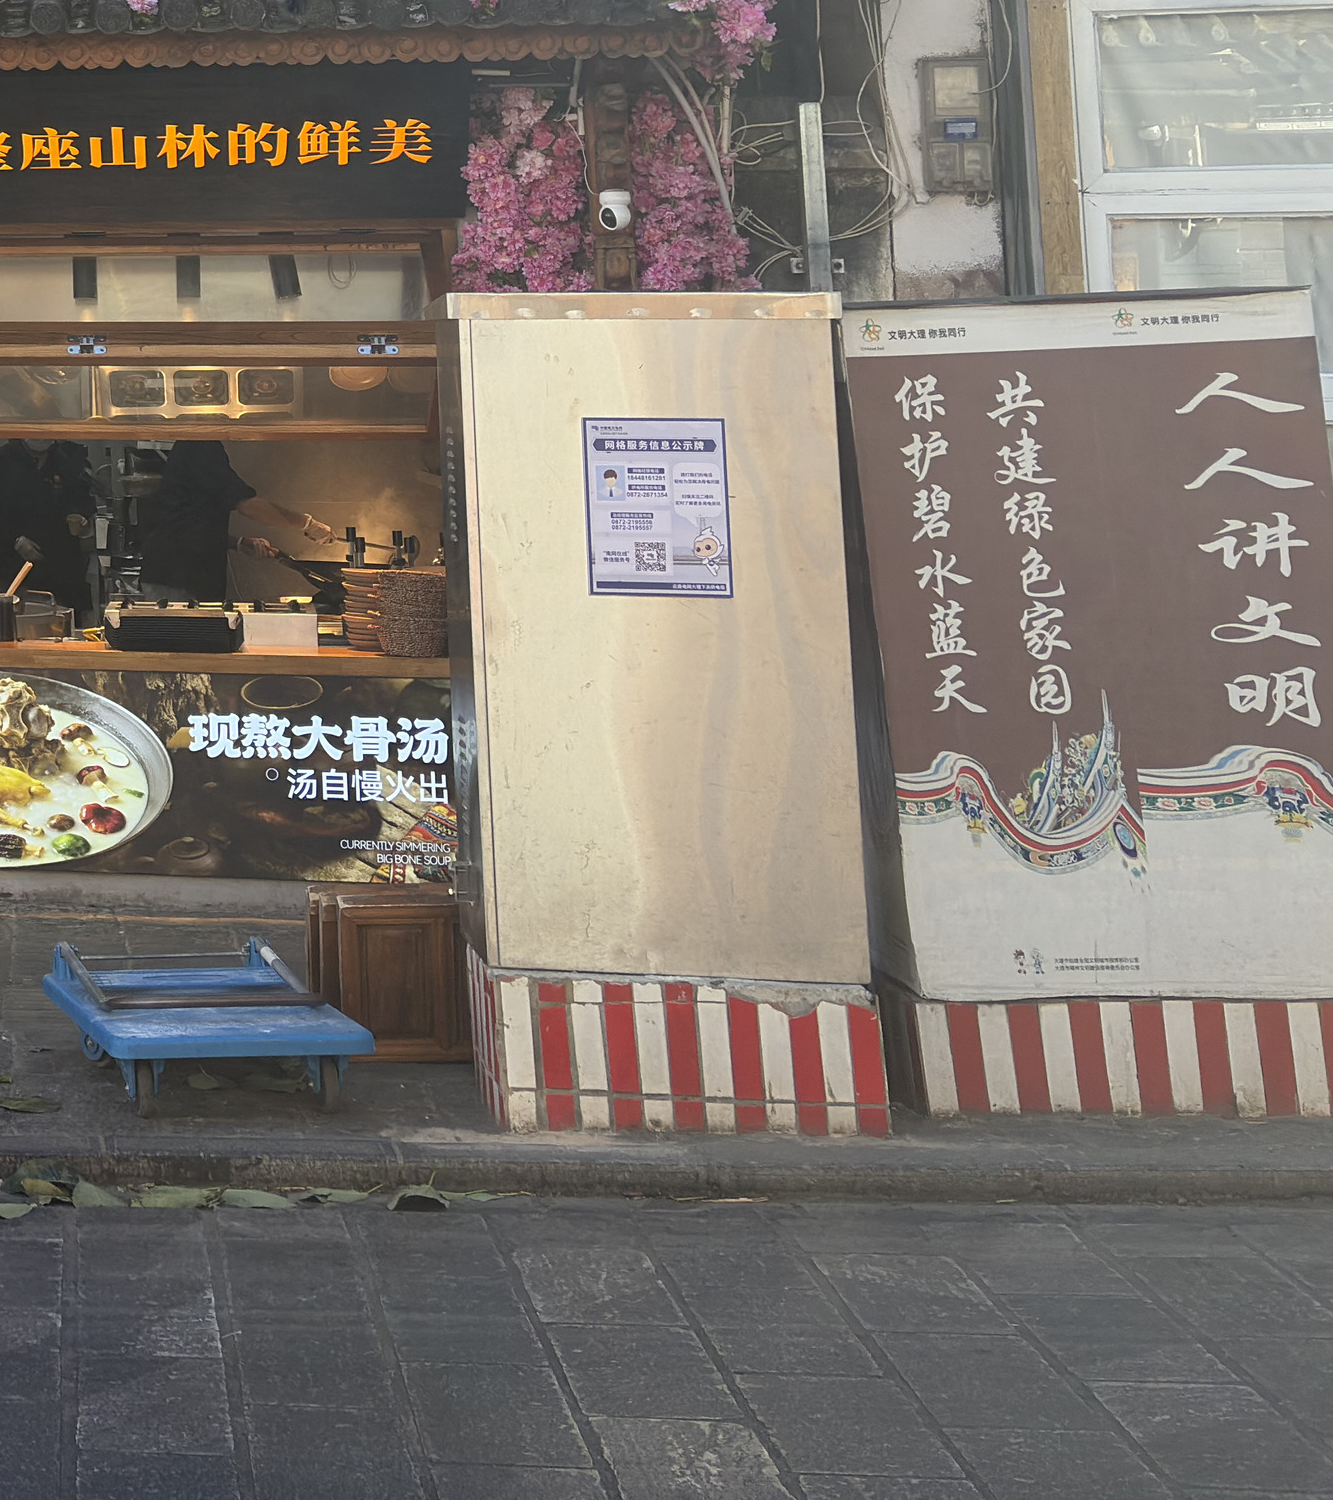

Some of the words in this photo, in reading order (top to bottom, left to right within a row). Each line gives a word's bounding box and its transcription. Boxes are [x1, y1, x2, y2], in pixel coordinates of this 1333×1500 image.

[1141, 316, 1179, 326] 文明大理
[1181, 314, 1219, 324] 你我同行
[888, 329, 926, 340] 文明大理
[928, 327, 966, 339] 你我同行
[605, 440, 704, 450] 网格服务信息公示牌
[895, 374, 987, 714] 保护碧水蓝天
[986, 371, 1072, 715] 共建绿色家园
[1175, 372, 1321, 728] 人人讲文明
[187, 712, 449, 764] 现熬大骨汤
[287, 767, 449, 804] 汤自慢火出
[340, 839, 394, 851] CURRENTLY
[396, 841, 450, 852] SIMMERING
[377, 854, 393, 864] BIG
[395, 854, 422, 865] BONE
[424, 855, 451, 866] SOUP
